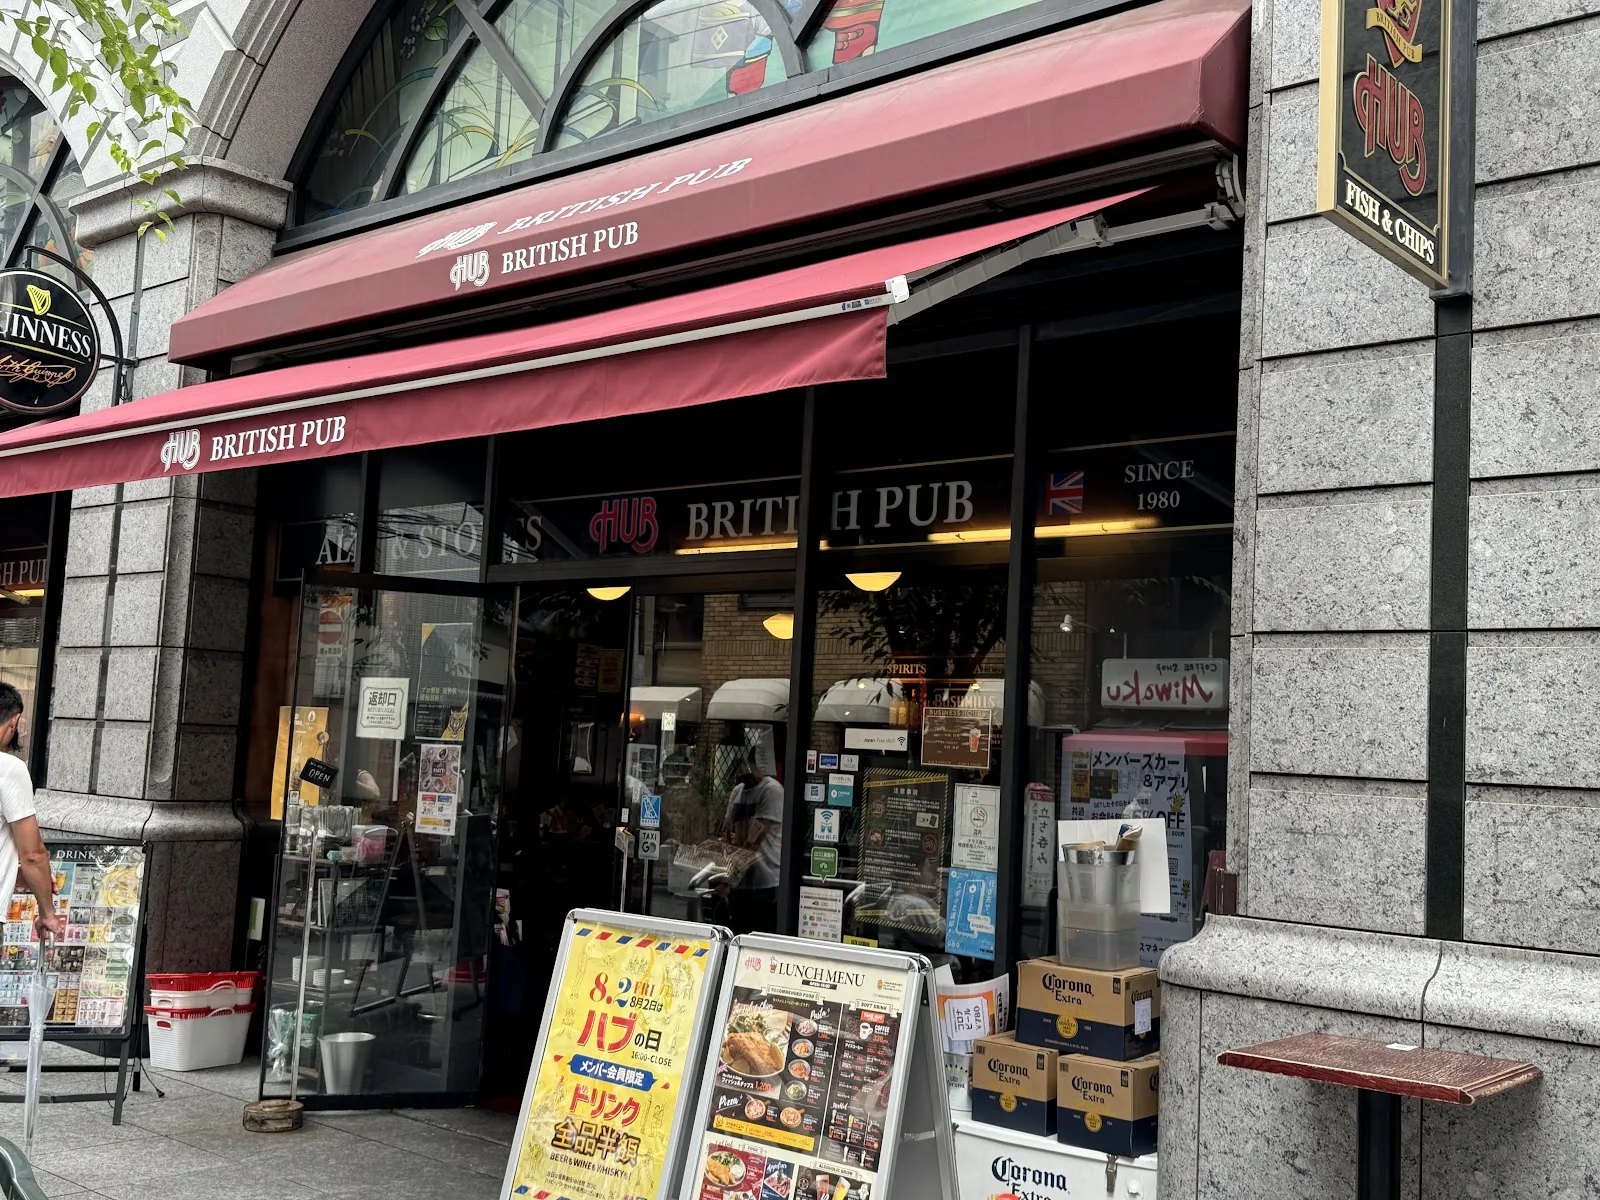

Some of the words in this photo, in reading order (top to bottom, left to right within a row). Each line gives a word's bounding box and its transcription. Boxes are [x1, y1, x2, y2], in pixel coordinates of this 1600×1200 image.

[1376, 11, 1401, 47] BRITISH
[1402, 41, 1416, 59] PUB
[1353, 53, 1427, 197] HUB
[415, 221, 497, 258] HUB
[498, 182, 663, 235] BRITISH
[657, 158, 752, 194] PUB
[1345, 179, 1380, 231] FISH
[1381, 208, 1393, 237] &
[1395, 217, 1435, 265] CHIPS
[450, 250, 490, 291] HUB
[501, 234, 589, 275] BRITISH
[593, 221, 639, 254] PUB
[160, 428, 200, 472] HUB
[210, 423, 297, 462] BRITISH
[300, 415, 347, 447] PUB
[1124, 460, 1195, 483] SINCE
[686, 488, 863, 541] BRITIH
[875, 480, 974, 528] PUB
[1137, 490, 1181, 511] 1980
[589, 496, 659, 553] HUB
[887, 663, 927, 674] SPIRITS
[368, 691, 397, 707] 返却口
[929, 709, 961, 717] BUSINESS
[308, 768, 332, 783] OPEN
[643, 832, 657, 841] TAXI
[56, 849, 96, 859] DRINK
[745, 956, 762, 972] HUB
[779, 962, 825, 982] LUNCH
[825, 970, 866, 987] MENU
[589, 972, 633, 1008] 8.2
[633, 981, 656, 997] FRI
[1042, 973, 1093, 995] Corona
[629, 995, 664, 1013] 8月2日は
[1055, 990, 1082, 1005] Extra
[579, 1060, 645, 1087] メンバー会員限定
[988, 1058, 1029, 1078] Corona
[999, 1072, 1021, 1085] Extra
[1072, 1075, 1113, 1095] Corona
[569, 1084, 641, 1127] ドリンク
[1083, 1090, 1105, 1104] Extra
[550, 1116, 642, 1167] 全品半額
[991, 1156, 1068, 1192] Corona
